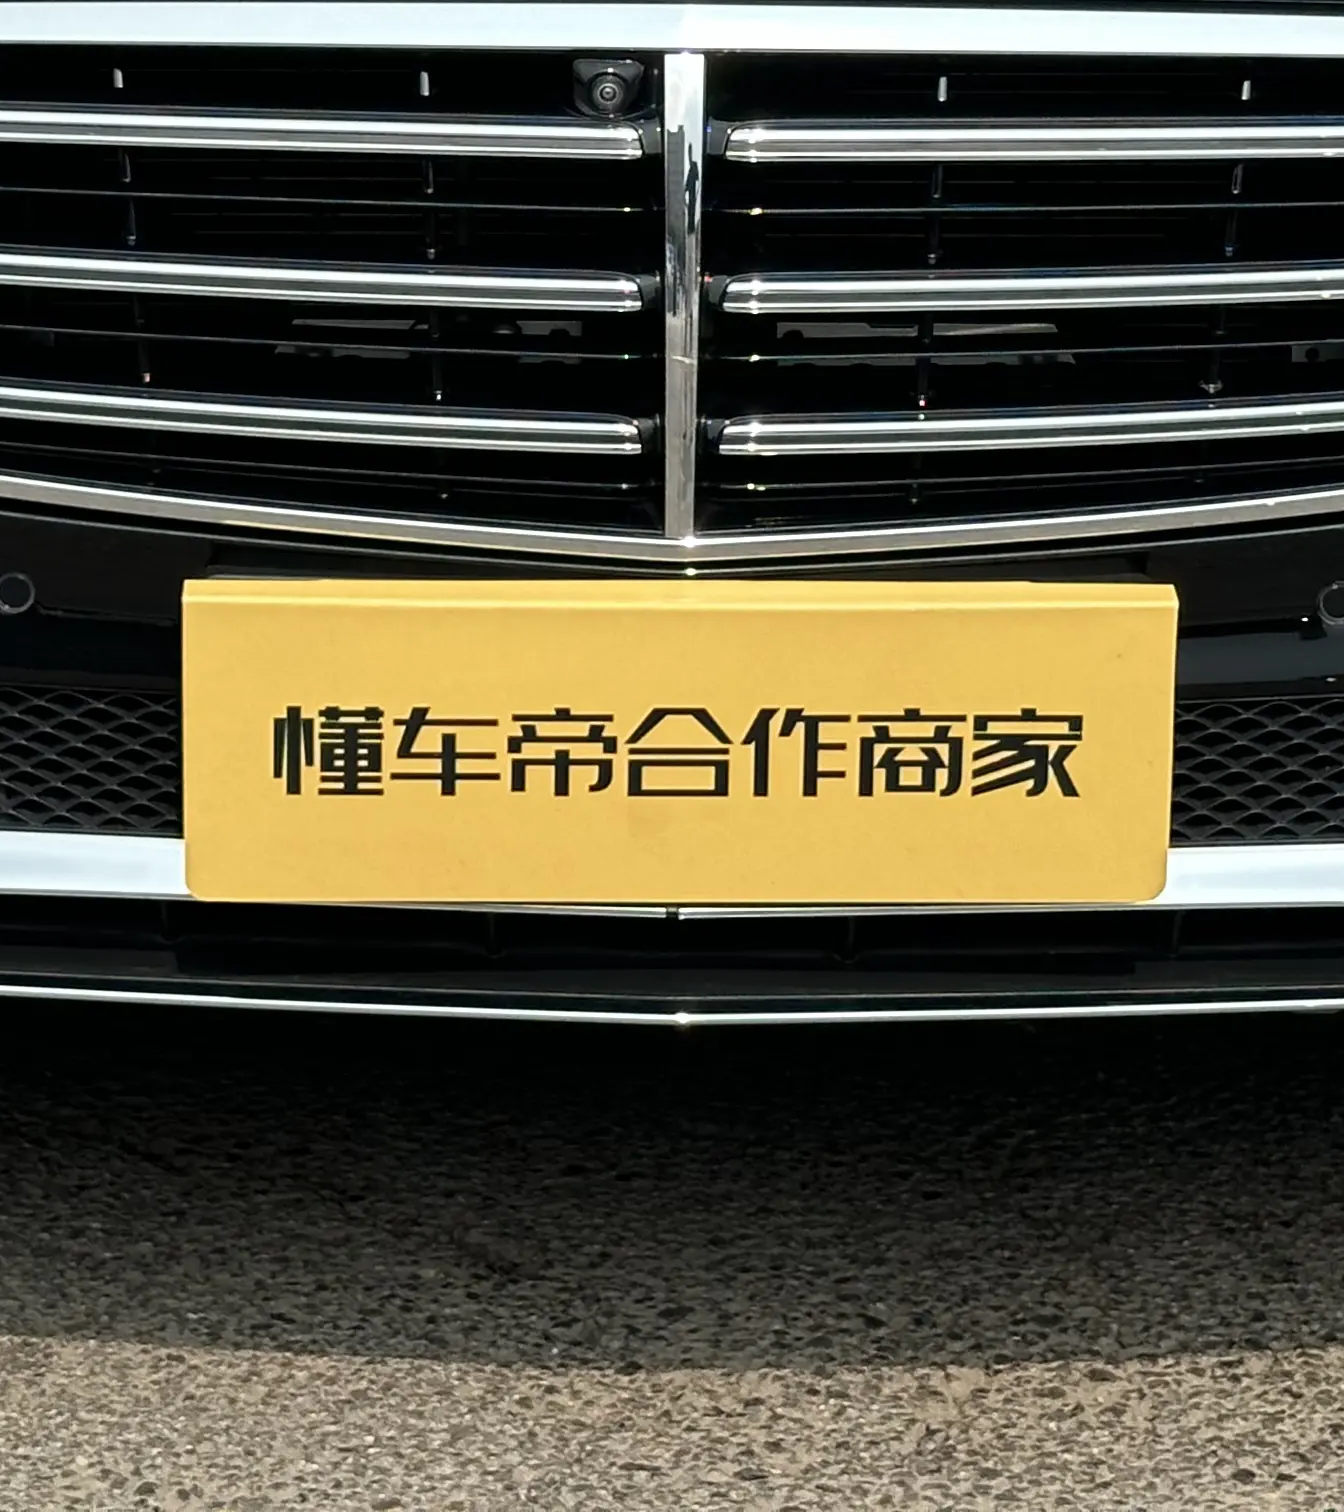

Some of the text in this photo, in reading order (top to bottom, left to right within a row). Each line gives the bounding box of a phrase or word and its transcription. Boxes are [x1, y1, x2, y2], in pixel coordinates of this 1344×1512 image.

[272, 705, 1085, 799] 懂车帝合作商家
